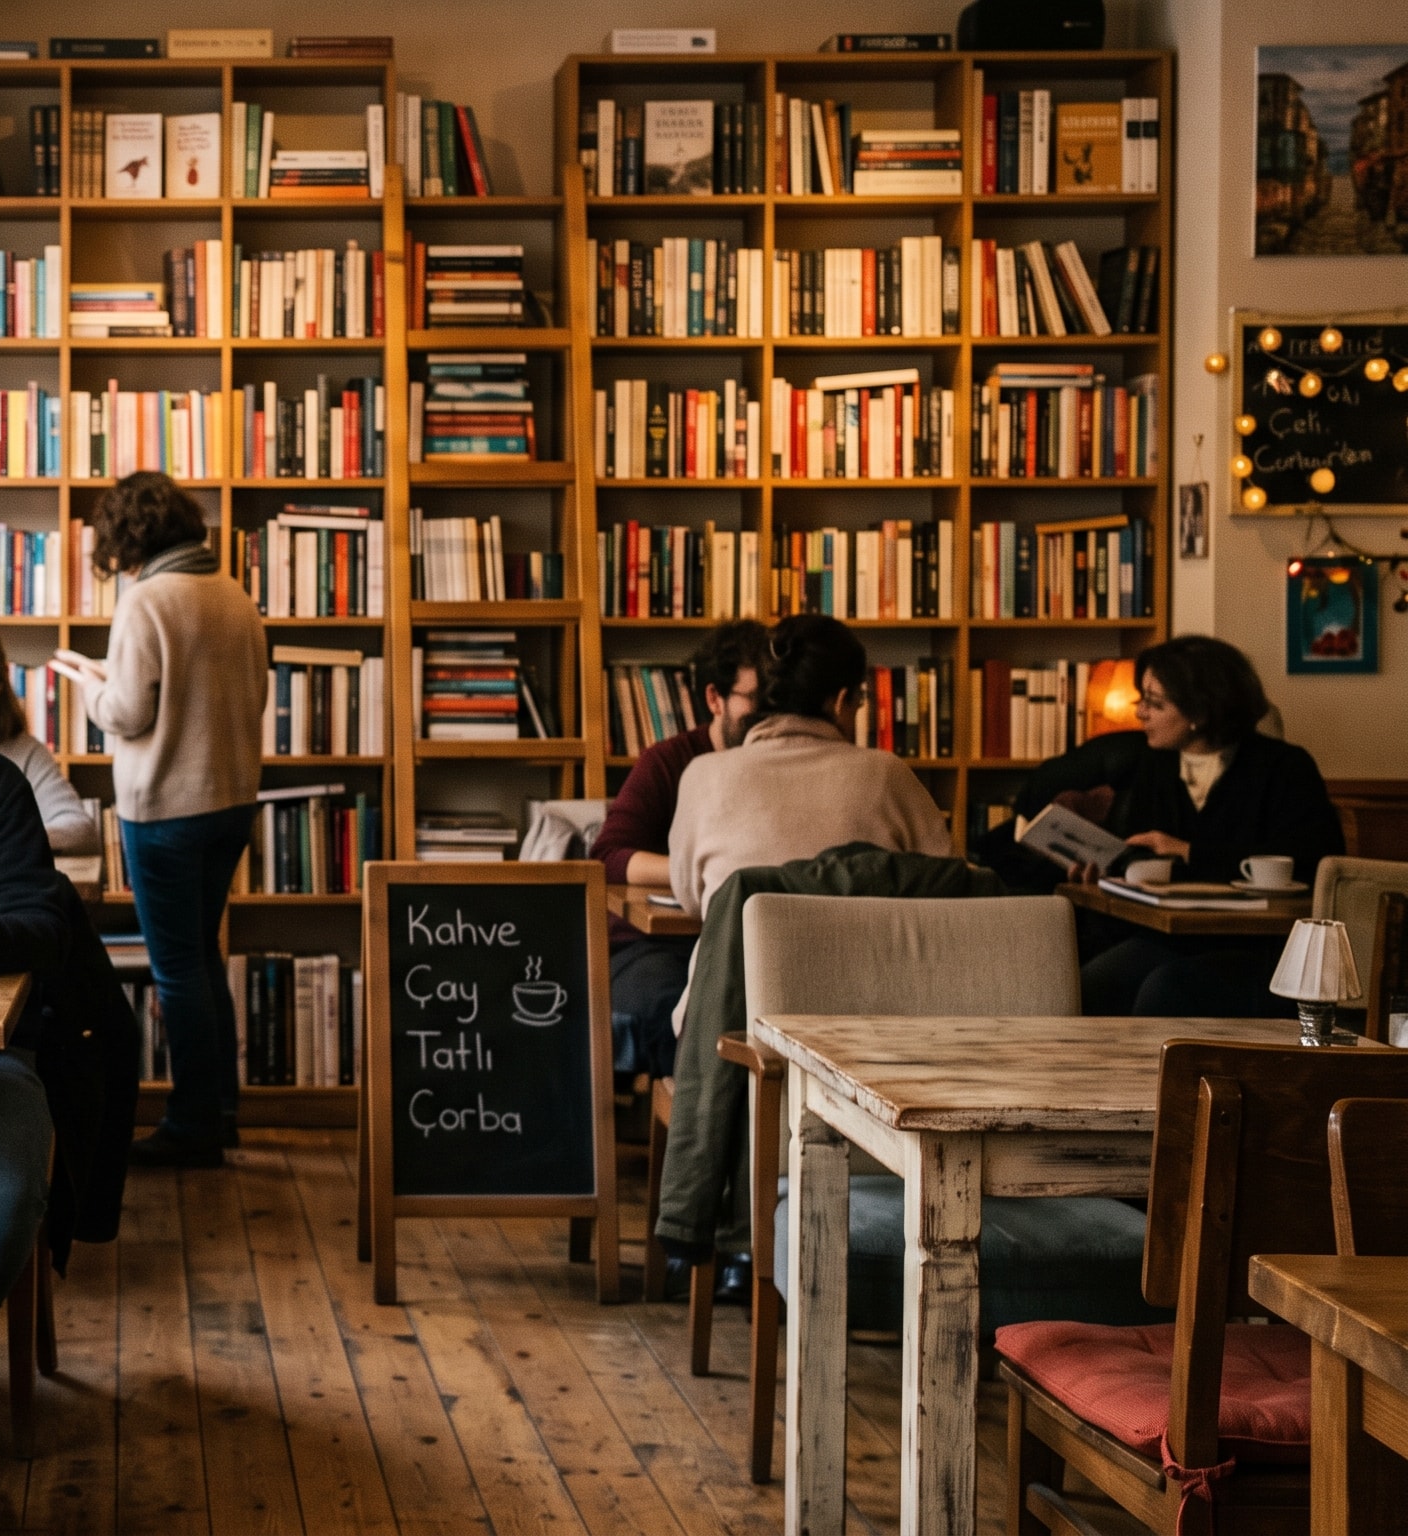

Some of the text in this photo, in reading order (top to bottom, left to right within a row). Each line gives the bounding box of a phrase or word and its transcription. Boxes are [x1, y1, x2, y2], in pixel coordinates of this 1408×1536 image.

[407, 904, 521, 946] Kahve
[404, 963, 479, 1024] Çay
[405, 1029, 493, 1071] Tatlı
[408, 1088, 523, 1138] Çorba
